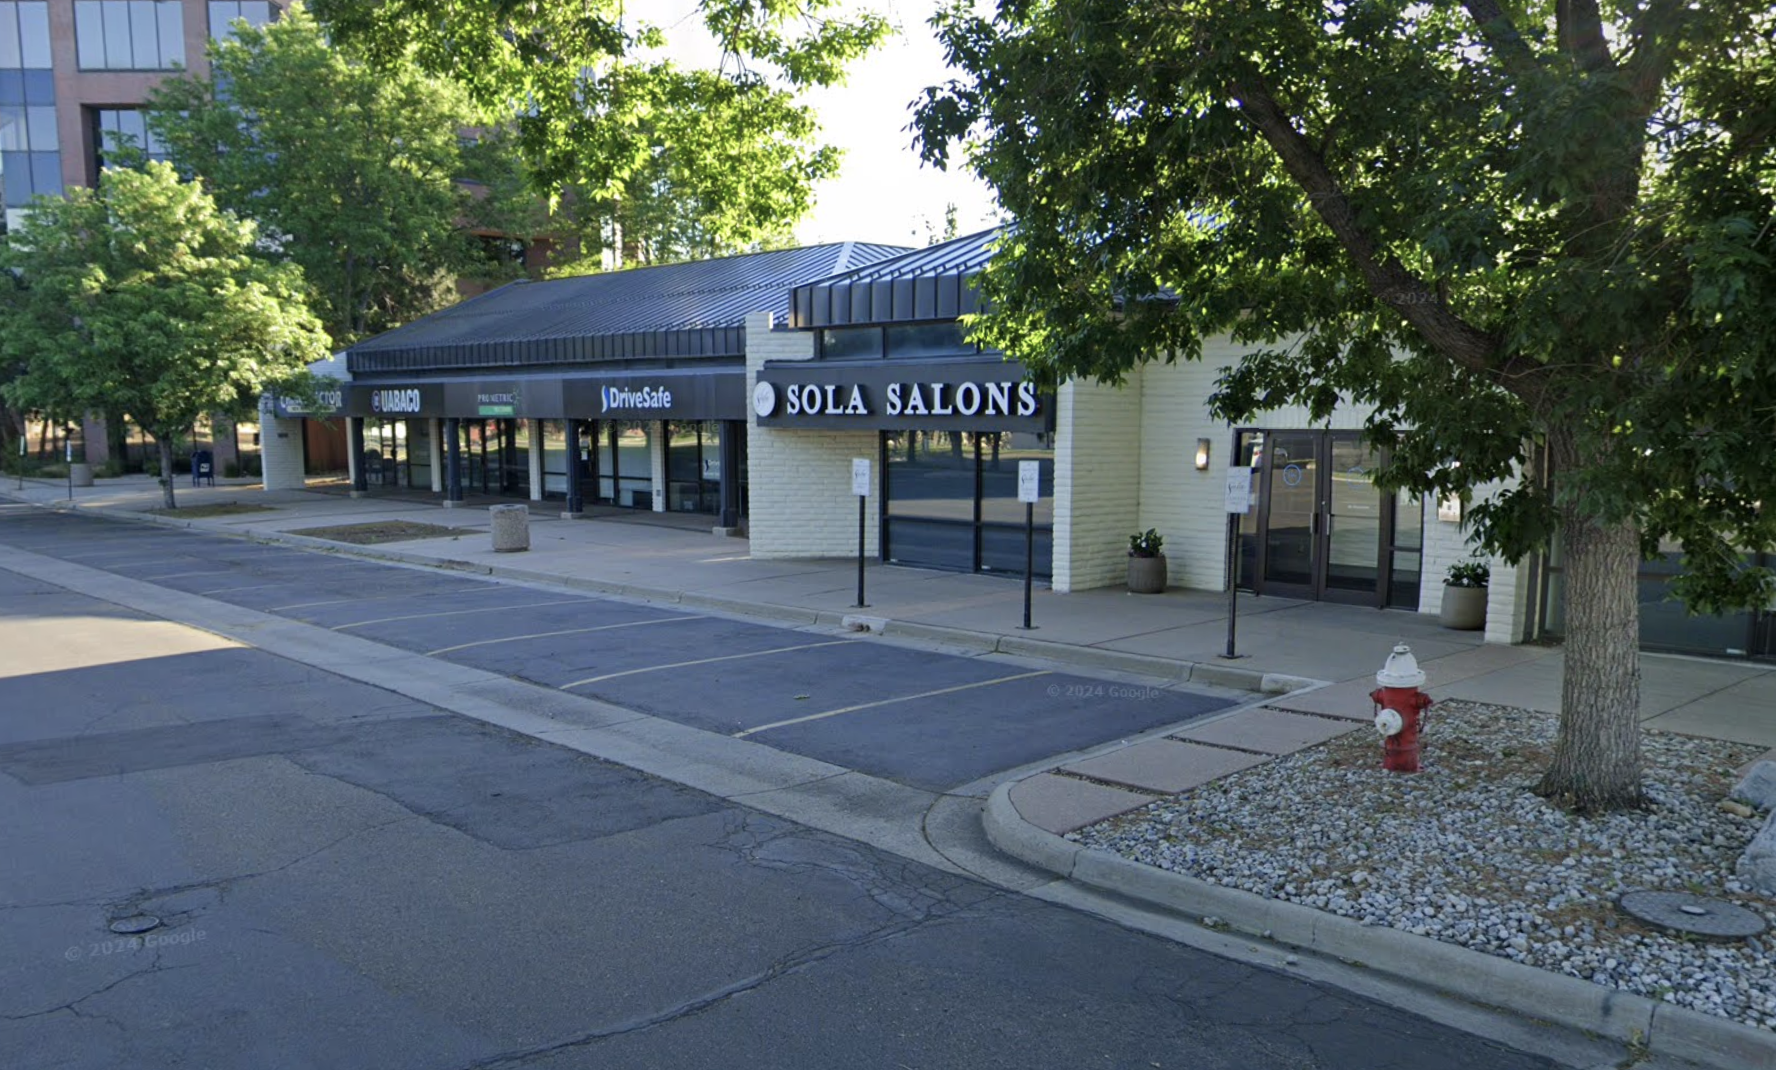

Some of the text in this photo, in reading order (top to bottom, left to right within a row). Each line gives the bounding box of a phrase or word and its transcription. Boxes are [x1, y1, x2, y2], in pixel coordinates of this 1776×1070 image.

[380, 389, 420, 412] UABACO
[609, 385, 672, 409] DriveSafe
[787, 384, 867, 415] SOLA
[886, 381, 1037, 416] SALONS
